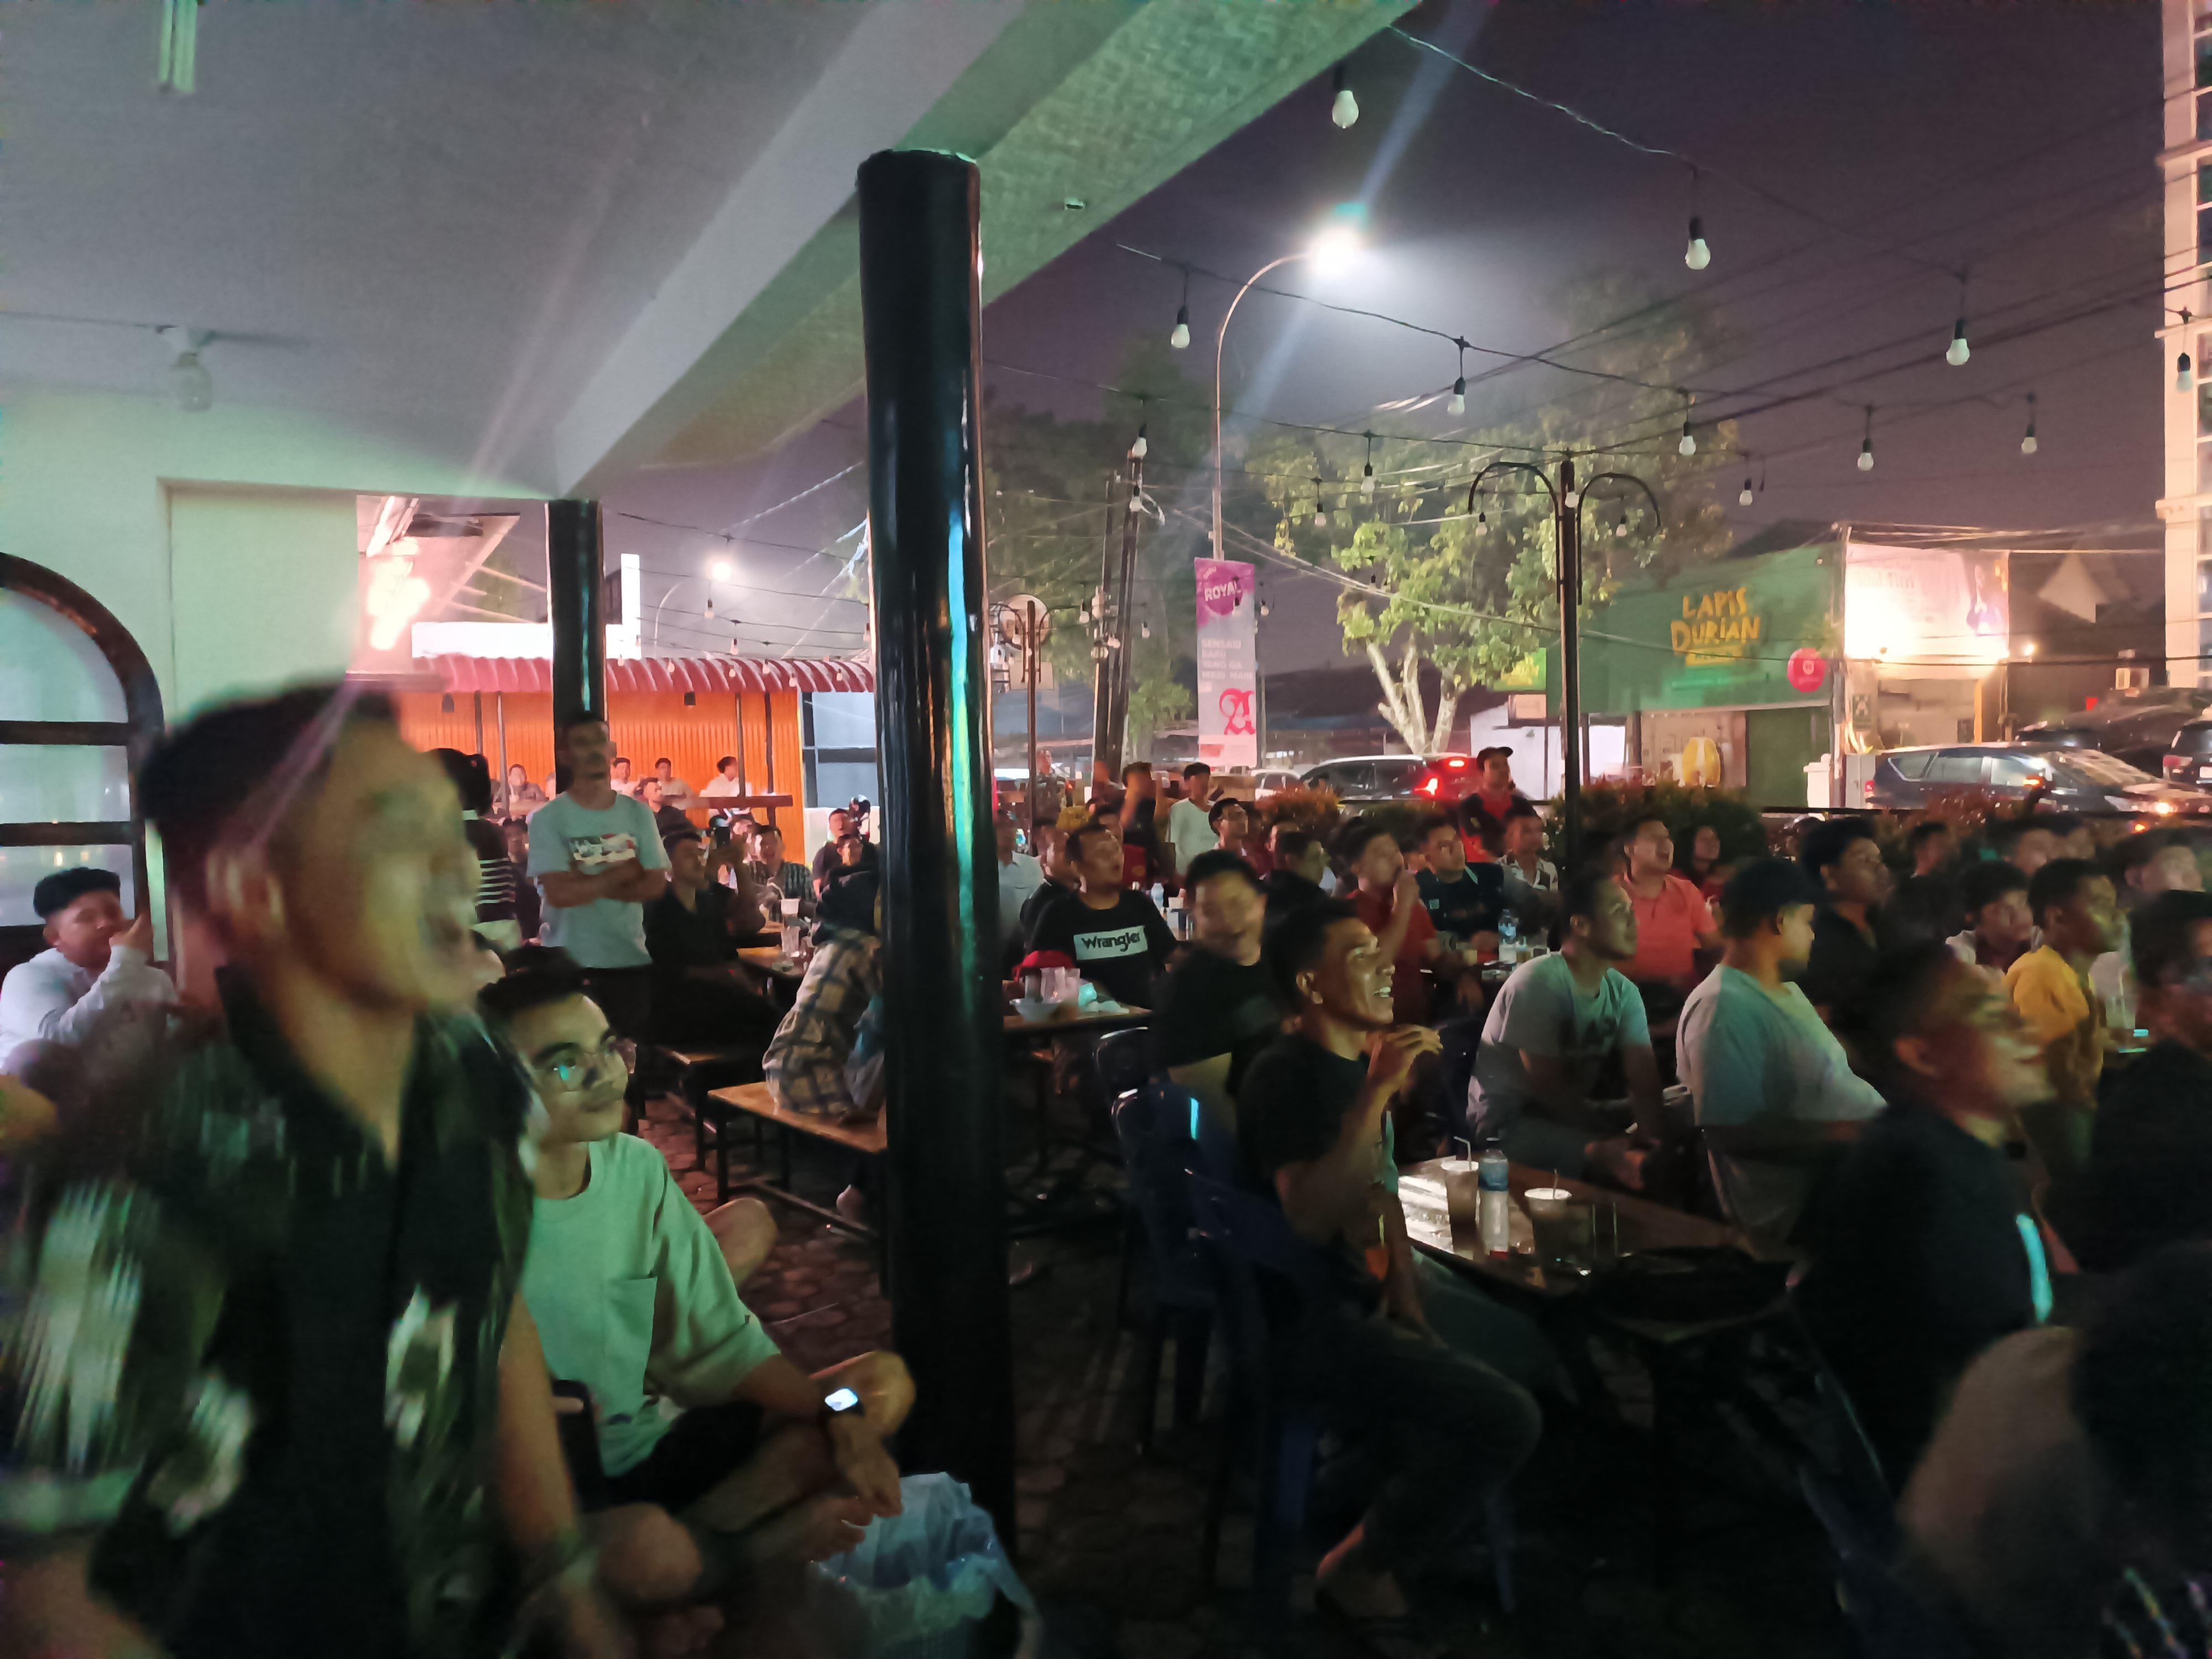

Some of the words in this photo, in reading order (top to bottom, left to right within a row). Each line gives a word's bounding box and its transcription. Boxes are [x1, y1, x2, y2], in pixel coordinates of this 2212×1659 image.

[1204, 581, 1242, 602] ROYAL
[1683, 587, 1747, 618] LAPIS
[1671, 615, 1761, 654] DURIAN
